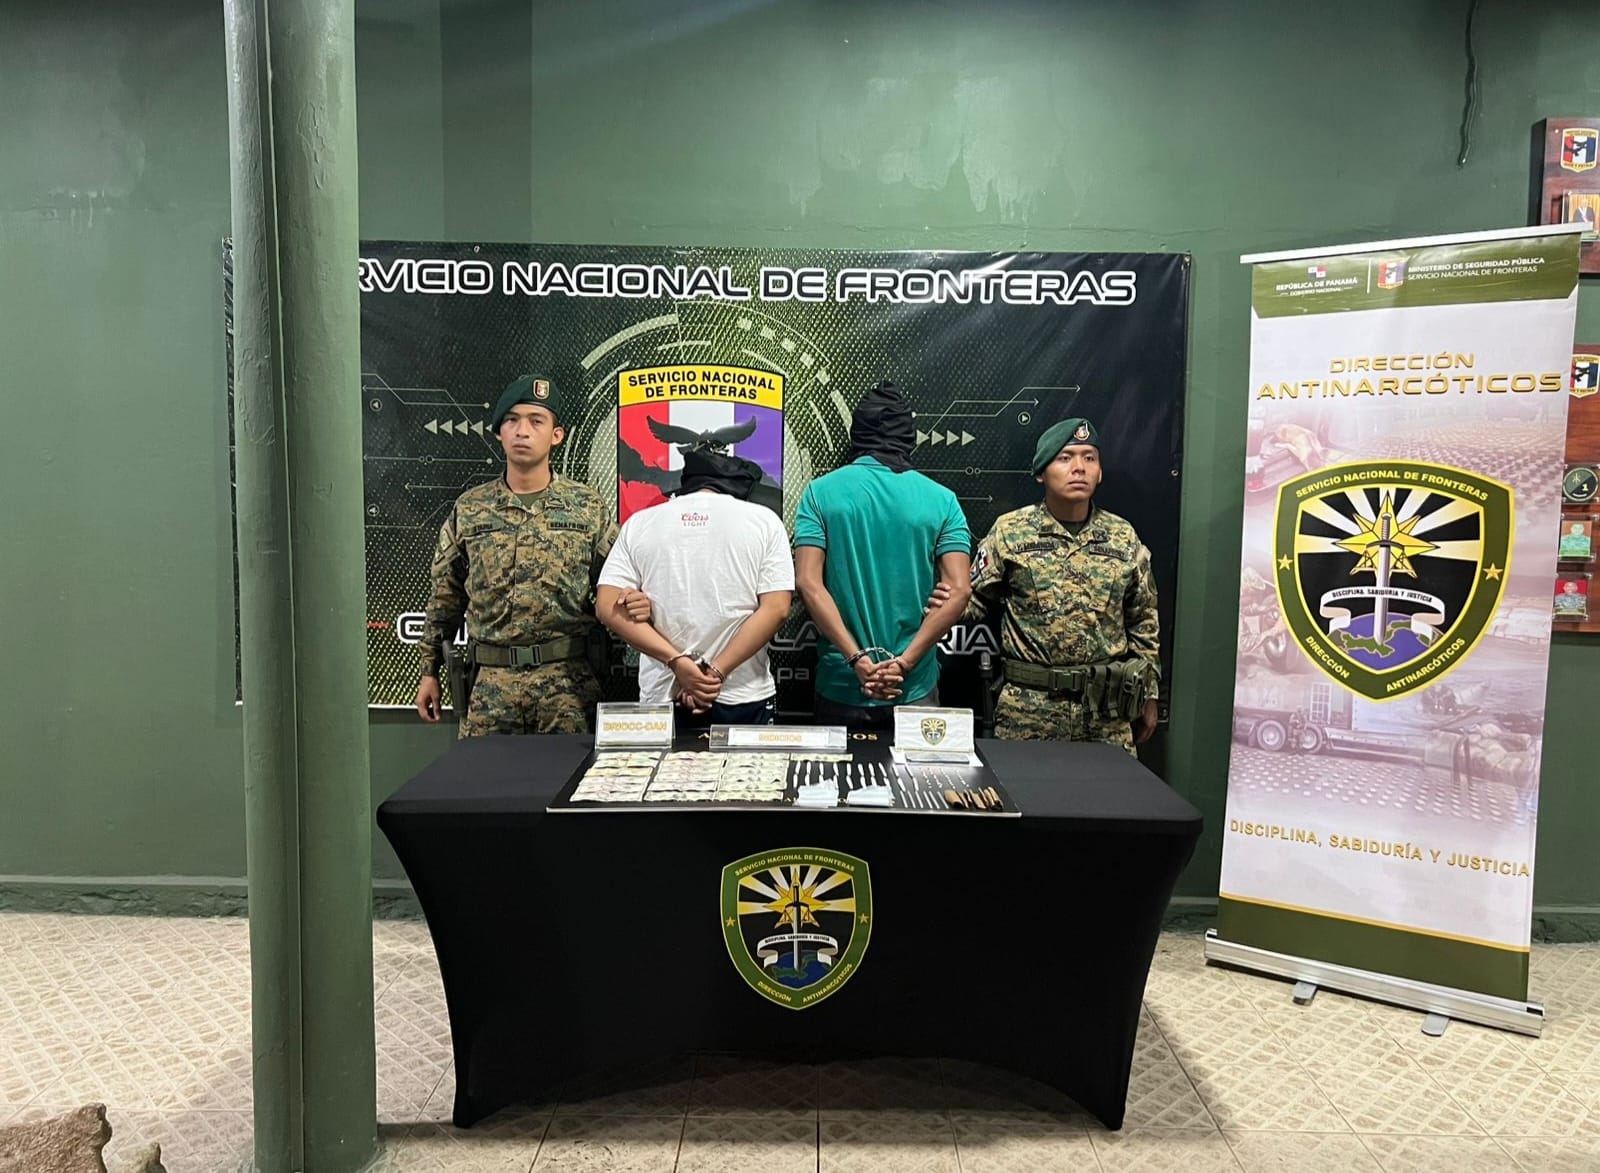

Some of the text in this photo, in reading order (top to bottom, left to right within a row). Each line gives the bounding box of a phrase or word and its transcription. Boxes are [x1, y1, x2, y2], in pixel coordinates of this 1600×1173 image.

[1408, 257, 1545, 272] MINISTERIO DE SEGURIDAD PÚBLICA
[1408, 265, 1537, 280] SERVICIO NACIONAL DE FRONTERAS
[358, 258, 1136, 305] RVICIO NACIONAL DE FRONTERAS
[1276, 281, 1313, 291] REPÚBLICA
[1326, 276, 1358, 286] PANAMÁ
[1329, 351, 1475, 373] DIRECCIÓN
[628, 371, 775, 390] SERVICIO NACIONAL
[645, 384, 757, 399] DE FRONTERAS
[1257, 372, 1561, 400] ANTINARCÓTICOS
[1296, 470, 1489, 501] SERVICIO NACIONAL DE FRONTERAS
[1305, 635, 1350, 679] DIRECCIÓN
[1386, 637, 1466, 692] ANTINARCÓTICOS
[1230, 818, 1529, 877] DISCIPLINA, SABIDURÍA Y JUSTICIA
[735, 860, 766, 876] SERVICIO
[767, 854, 802, 863] NACIONAL
[815, 855, 855, 871] FRONTERAS
[757, 980, 792, 1002] DIRECCIÓN
[802, 963, 853, 1003] ANTINARCÓTICOS
